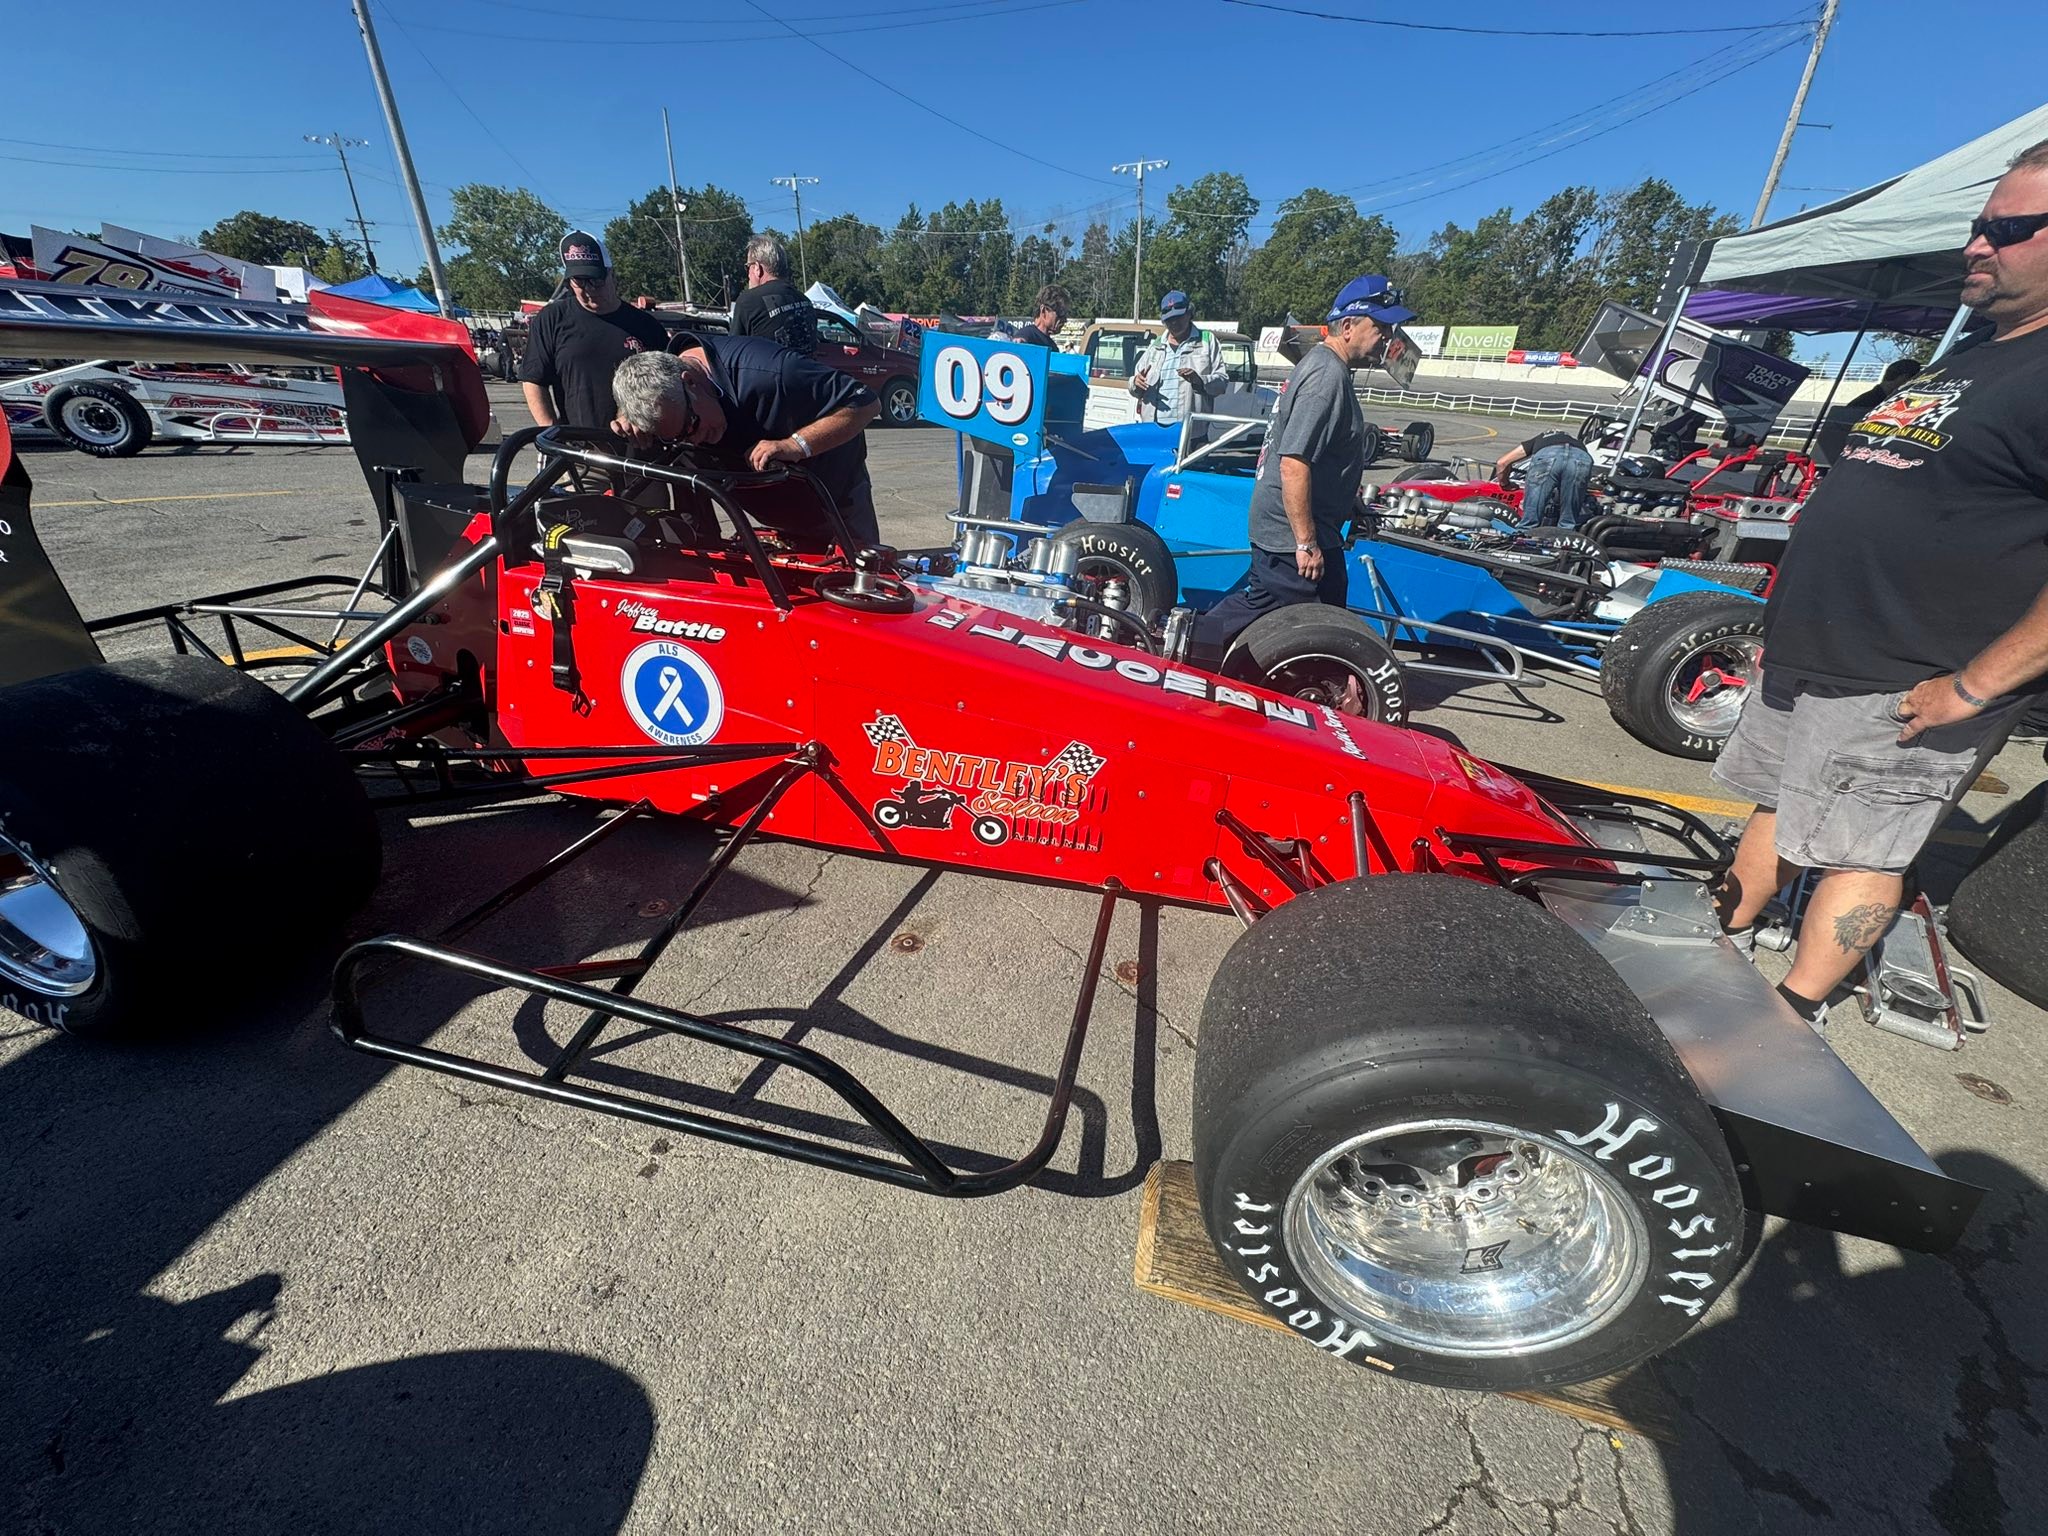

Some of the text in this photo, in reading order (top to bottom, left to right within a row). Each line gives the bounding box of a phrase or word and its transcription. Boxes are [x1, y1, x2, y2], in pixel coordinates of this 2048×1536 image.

[1450, 332, 1513, 348] Novelis
[934, 345, 1034, 424] 09
[1745, 373, 1780, 390] ROAD
[1752, 364, 1796, 387] TRACEY
[70, 385, 122, 407] Hoosier
[272, 403, 330, 417] SHARK
[1081, 534, 1152, 576] Hoosier
[615, 599, 658, 618] Jeffrey
[633, 614, 726, 641] Battle
[1680, 622, 1764, 651] Hoosi
[659, 643, 679, 657] ALS
[1366, 658, 1402, 722] Hoos
[648, 724, 703, 745] AWARENESS
[874, 739, 1088, 804] BENTLEY'S
[972, 790, 1079, 823] Saloon
[1555, 1100, 1734, 1317] Hoosier
[1223, 1191, 1377, 1359] Hoosier
